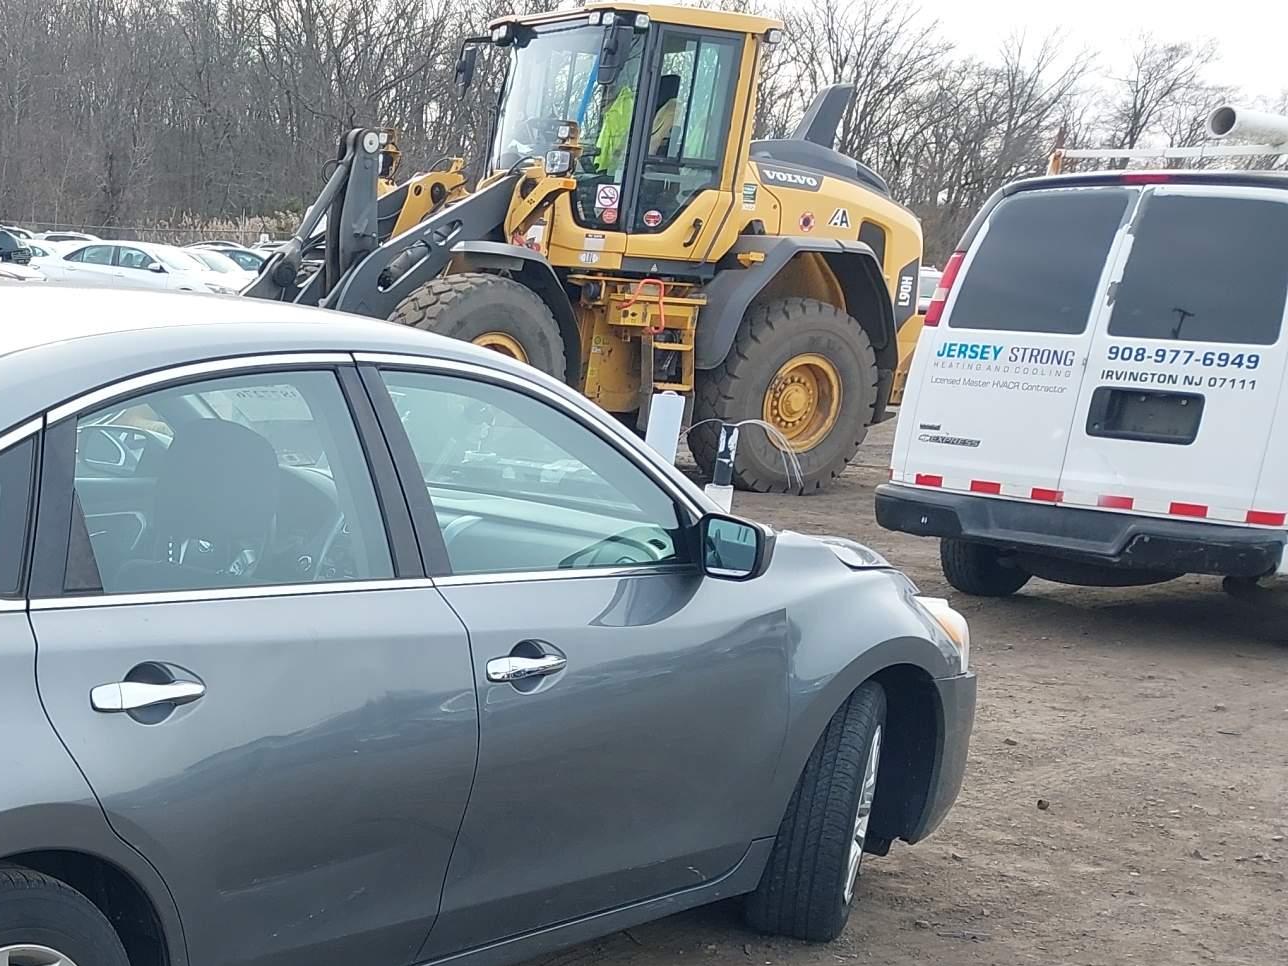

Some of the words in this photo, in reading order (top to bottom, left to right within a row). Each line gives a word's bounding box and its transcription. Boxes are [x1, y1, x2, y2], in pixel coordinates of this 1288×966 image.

[763, 170, 818, 187] VOLVO
[898, 275, 914, 307] L90H
[936, 342, 1004, 361] JERSEY
[1008, 346, 1076, 367] STRONG
[1106, 345, 1261, 370] 908-977-6949
[933, 361, 982, 371] HEATING
[985, 364, 1010, 374] AND
[1014, 366, 1073, 378] COOLING
[1100, 369, 1179, 385] IRVINGTON
[1182, 375, 1204, 387] NJ
[1207, 376, 1257, 391] 07111
[930, 375, 961, 386] Licensed
[962, 377, 991, 388] Master
[1021, 382, 1068, 394] Contractor
